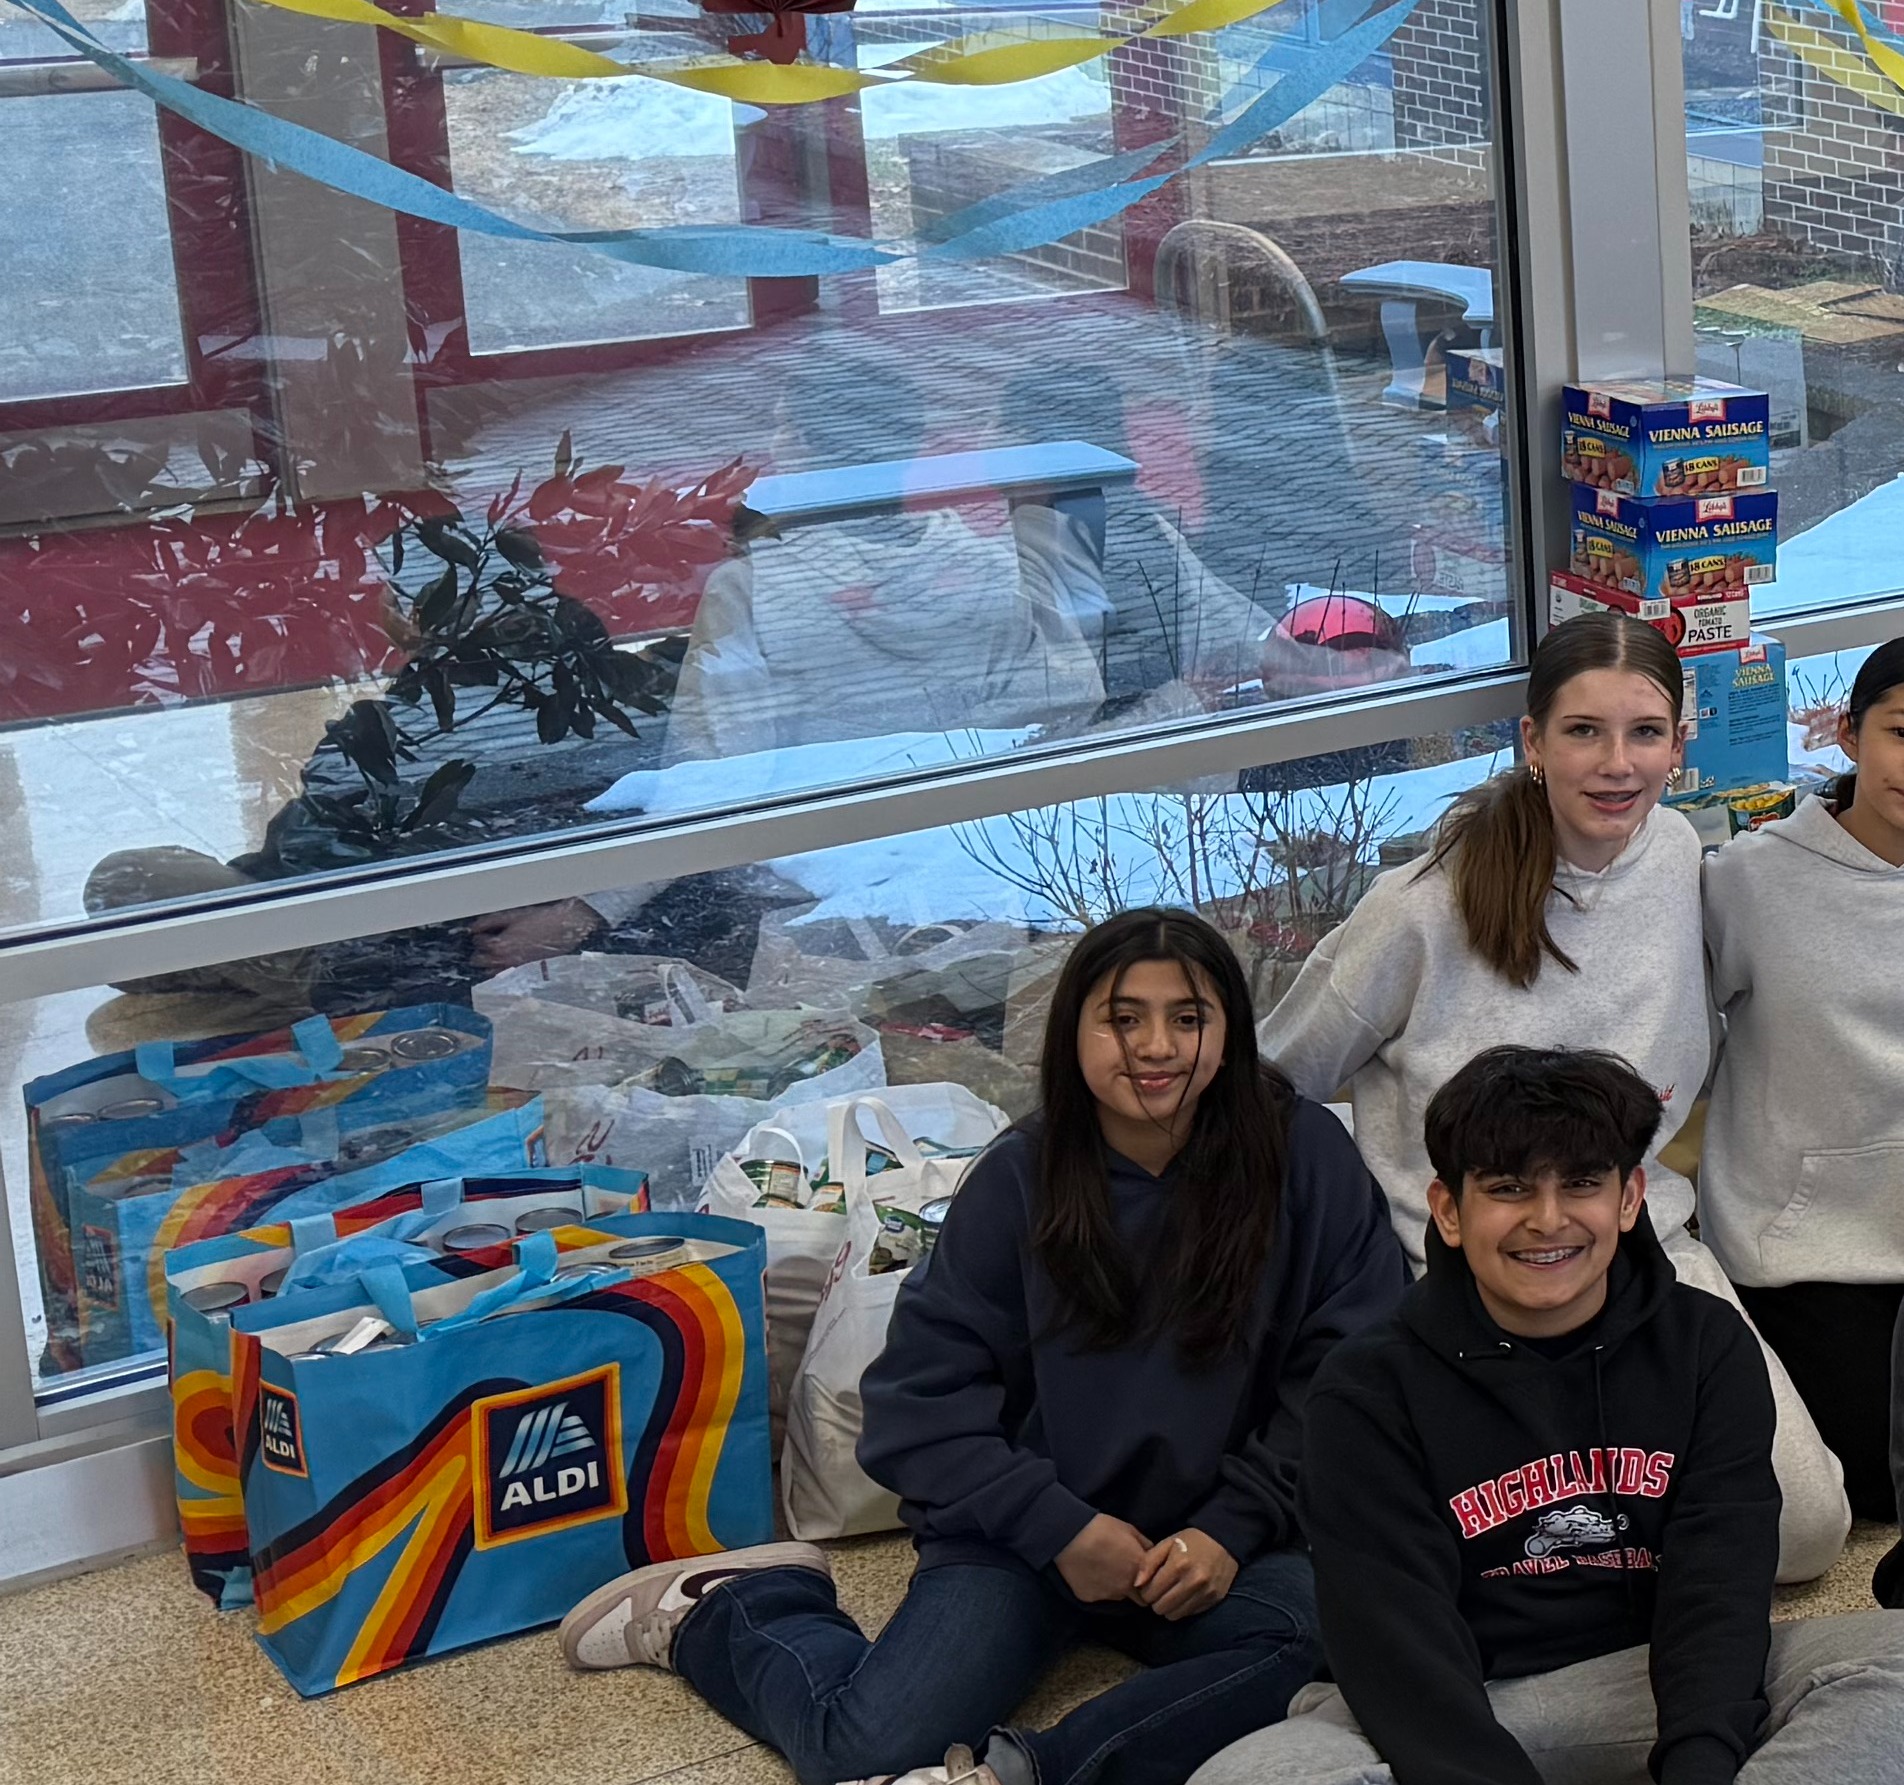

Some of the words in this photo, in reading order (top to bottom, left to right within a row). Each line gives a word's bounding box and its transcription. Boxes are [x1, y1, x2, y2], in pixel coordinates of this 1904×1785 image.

[1649, 427, 1701, 444] VIENNA
[1705, 420, 1765, 439] SAUSAGE
[1656, 526, 1709, 544] VIENNA
[1713, 518, 1773, 537] SAUSAGE
[1693, 605, 1728, 619] ORGANIC
[1698, 616, 1723, 628] TOMATO
[1688, 625, 1733, 644] PASTE
[264, 1435, 297, 1460] ALDI
[500, 1460, 600, 1512] ALDI
[1449, 1446, 1676, 1541] HIGHLANDS
